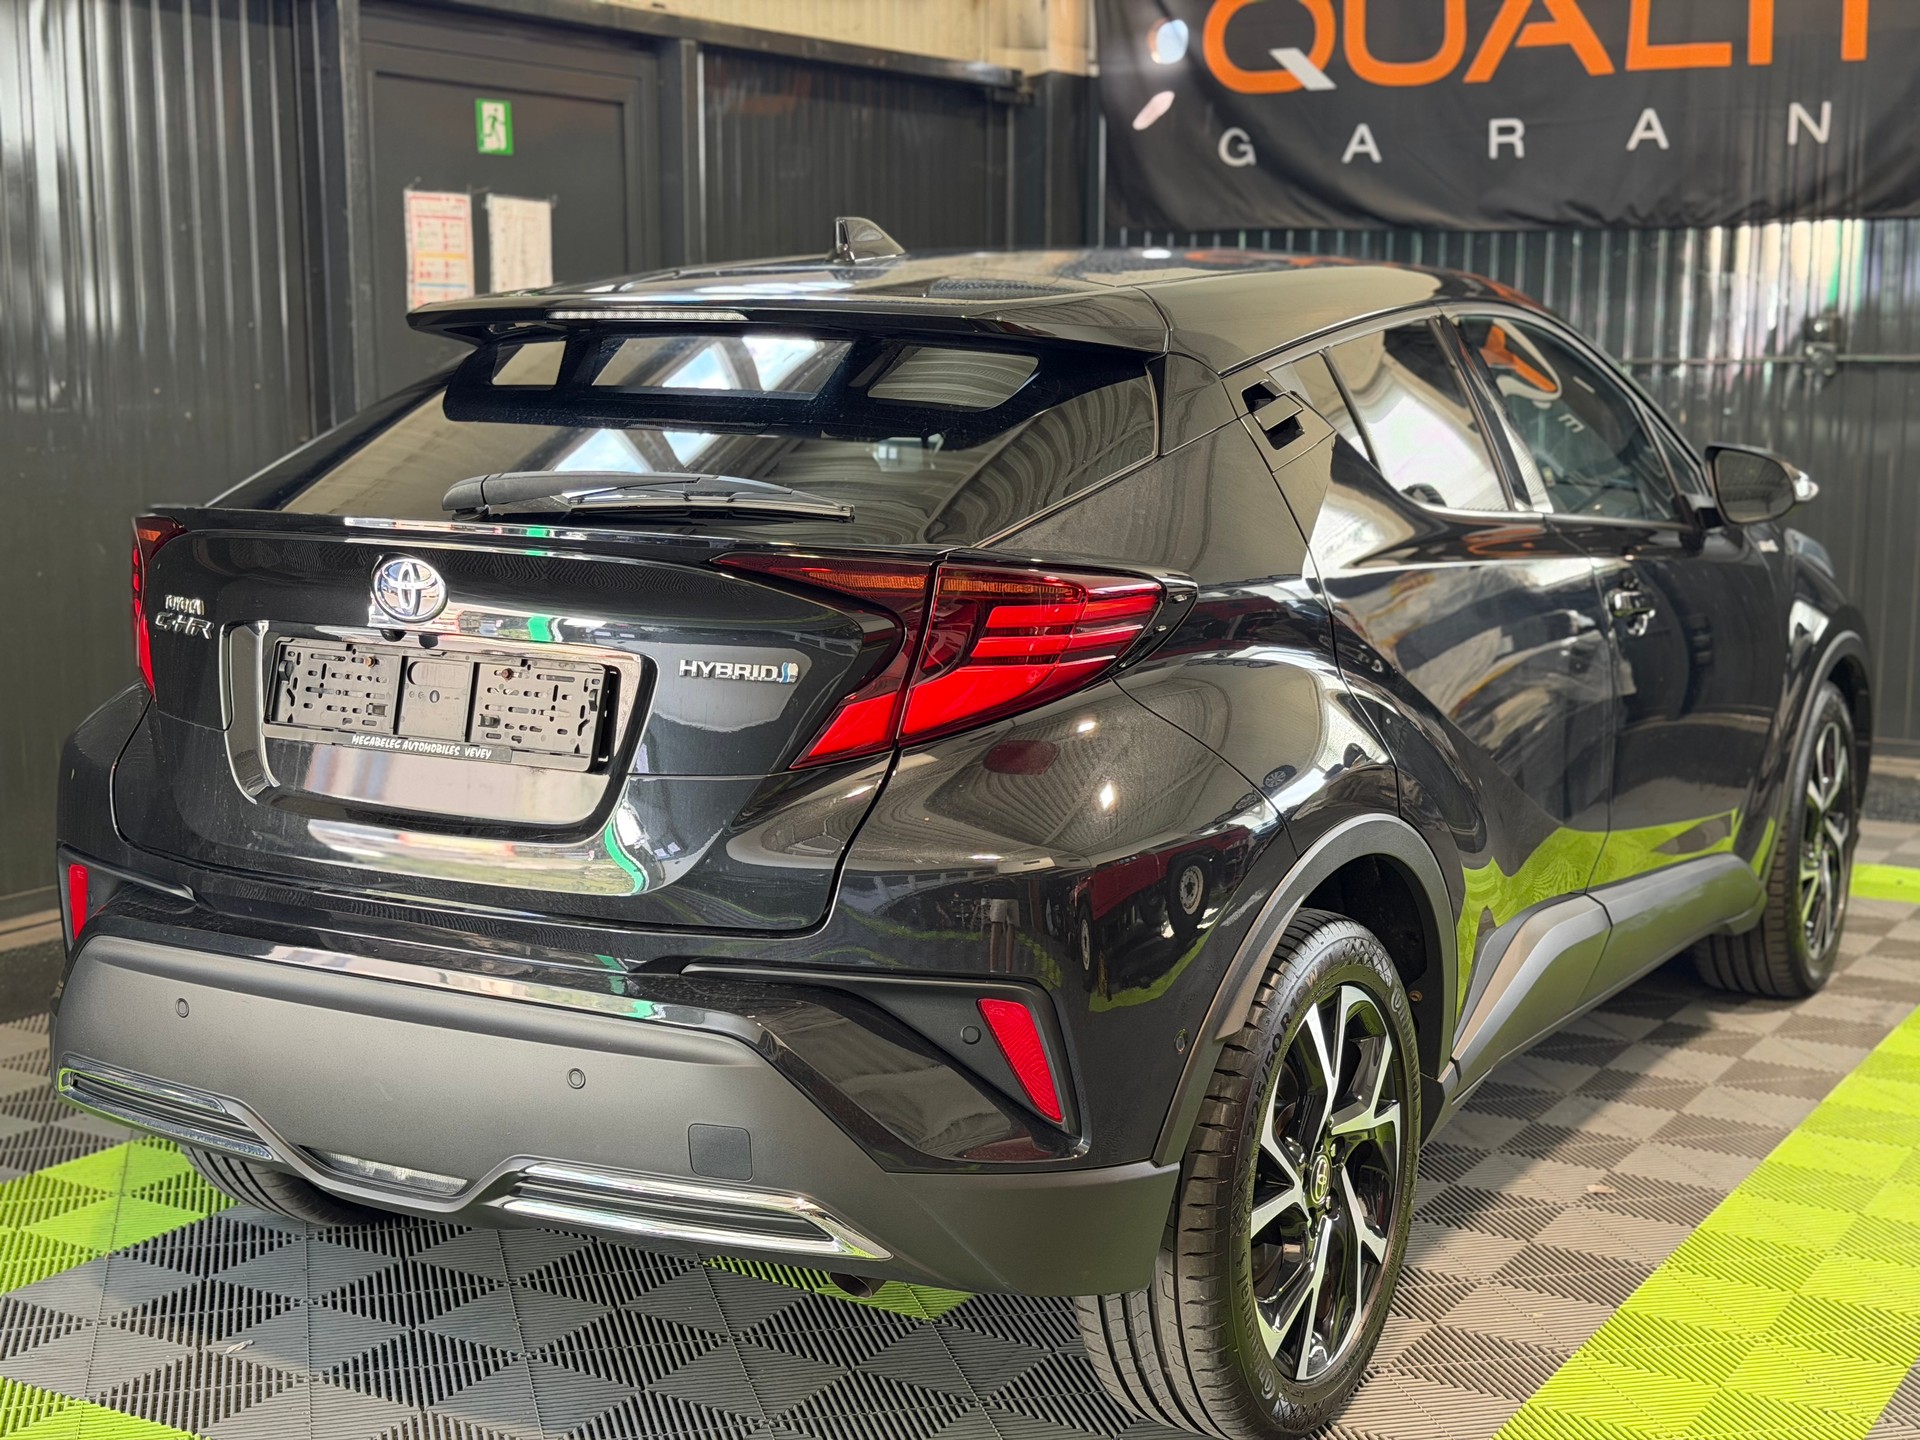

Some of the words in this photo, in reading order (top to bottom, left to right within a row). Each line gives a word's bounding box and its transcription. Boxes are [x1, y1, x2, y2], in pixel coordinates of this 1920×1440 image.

[679, 659, 780, 682] HYBRID
[402, 741, 460, 756] AUTOMOBILES
[464, 747, 492, 760] VEVEY
